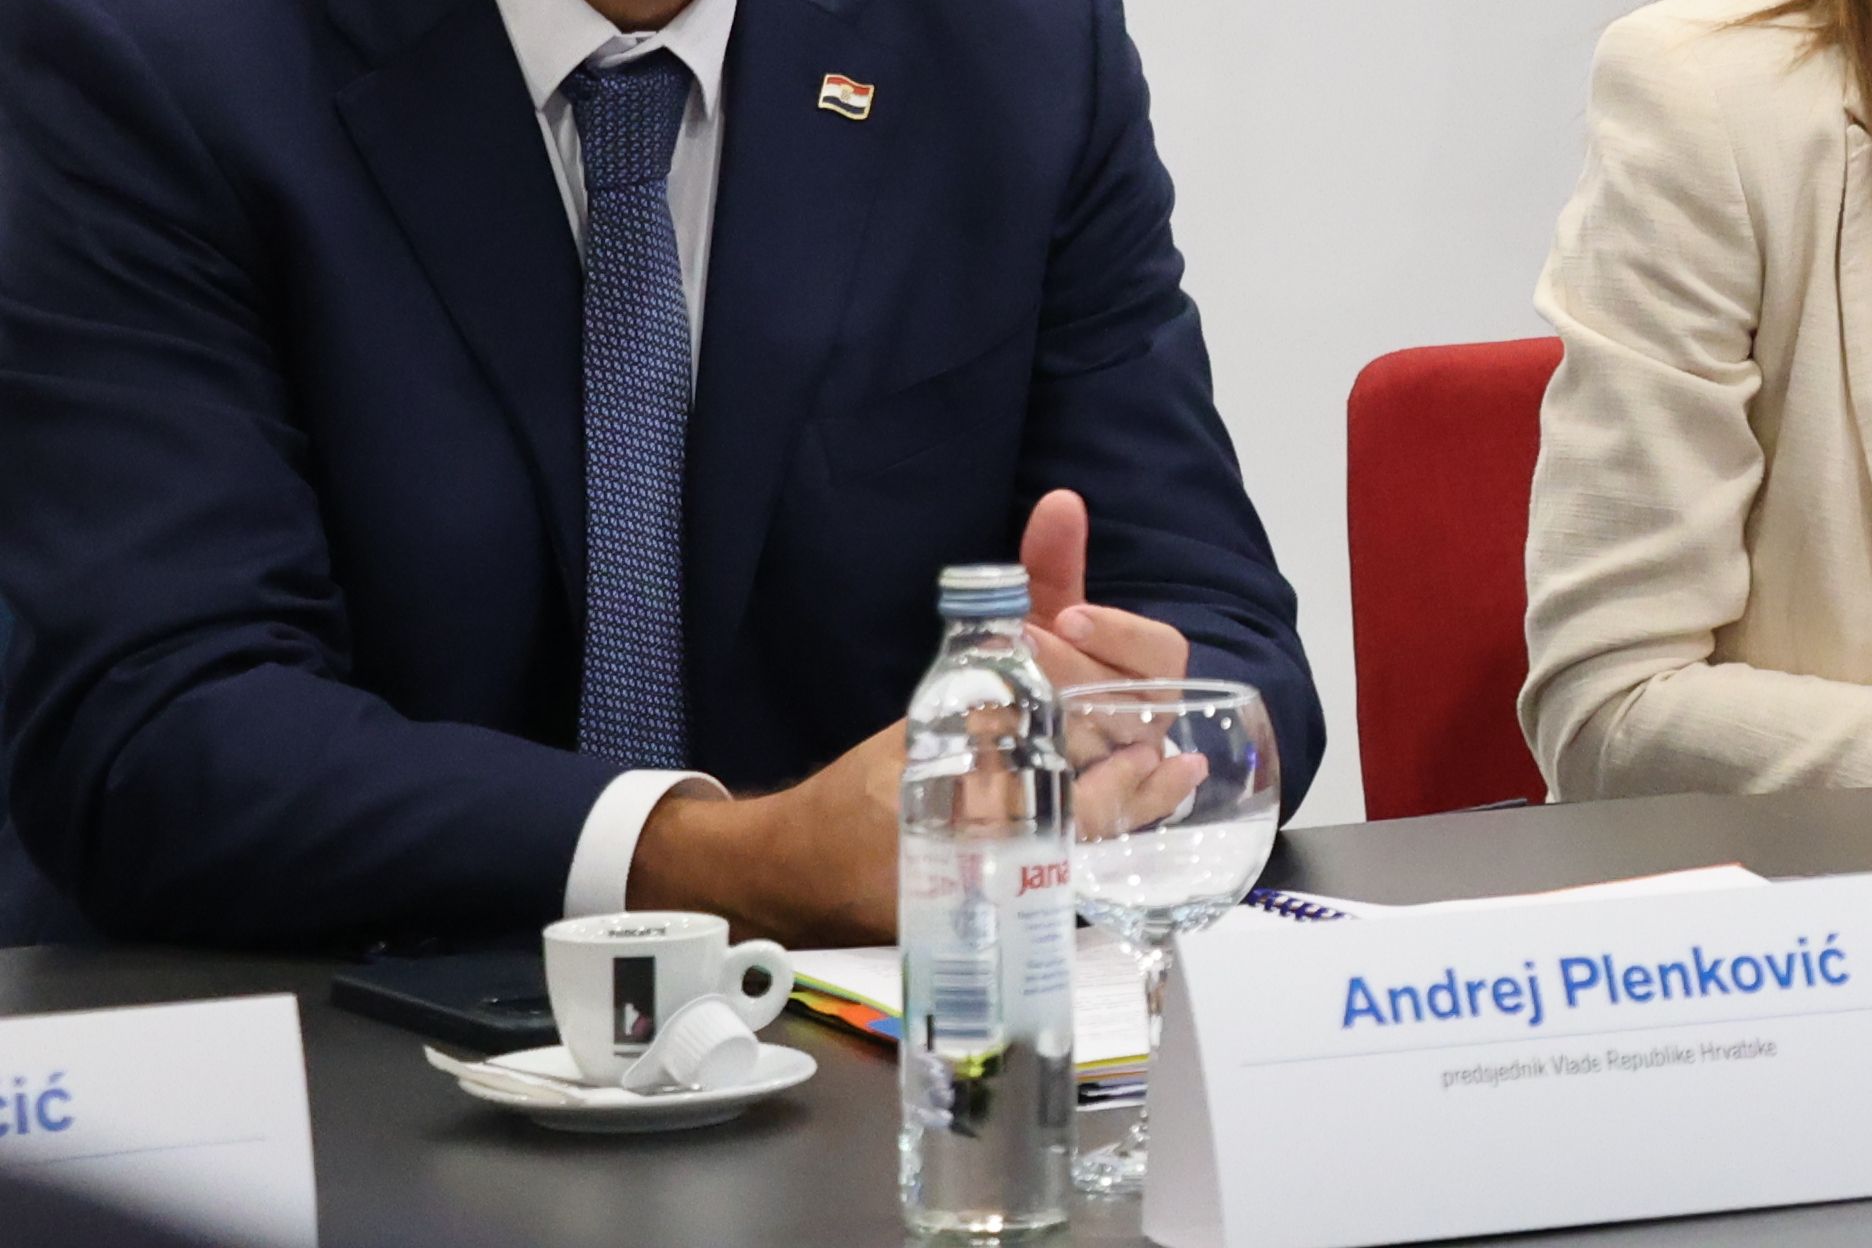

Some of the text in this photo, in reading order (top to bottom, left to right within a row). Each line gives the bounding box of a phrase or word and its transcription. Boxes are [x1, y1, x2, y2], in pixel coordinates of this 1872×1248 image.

[1341, 932, 1851, 1029] Andrej Plenković
[1441, 1037, 1777, 1090] predsjednik Vlade Republike Hrvatske
